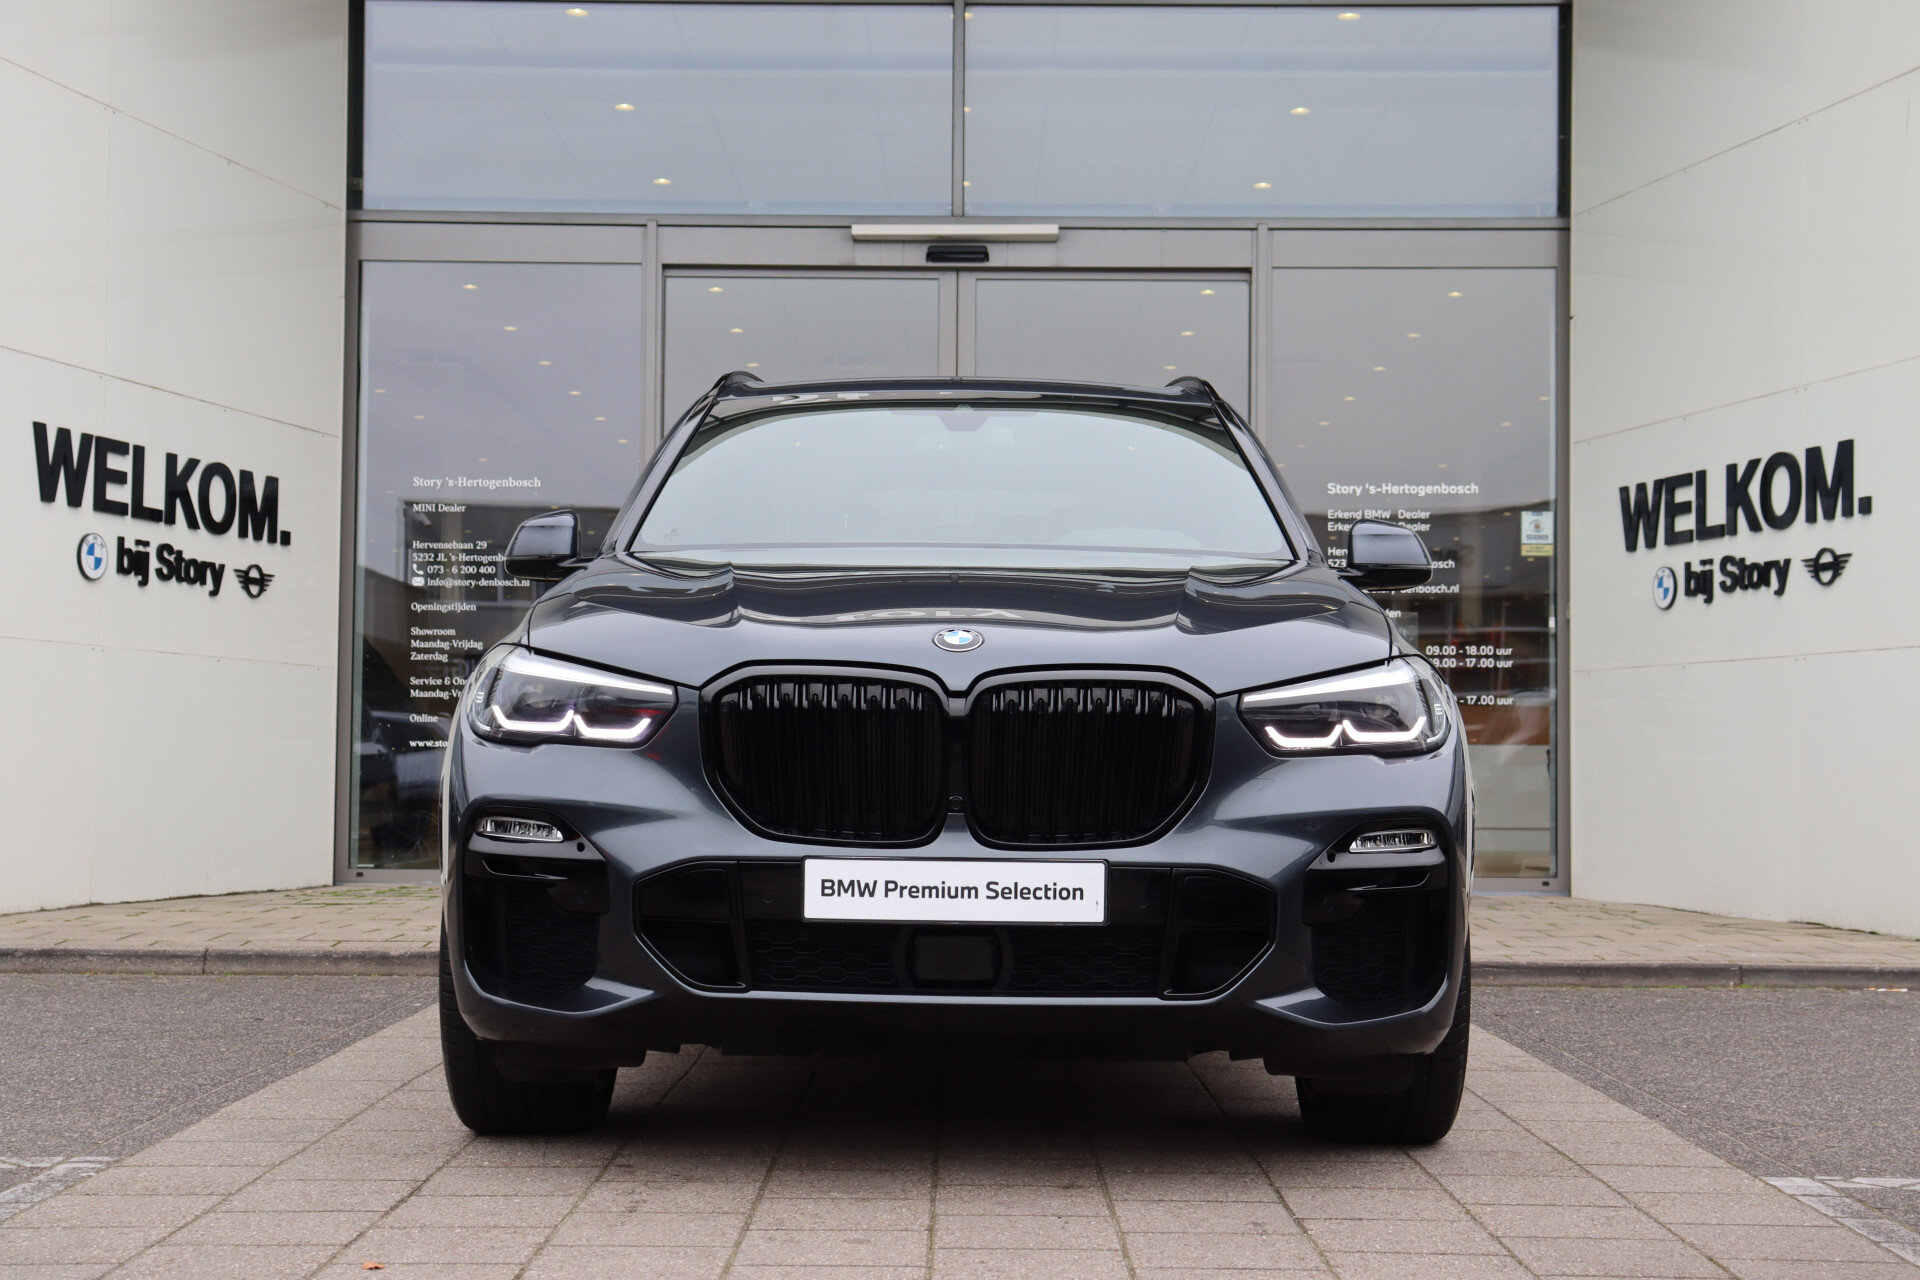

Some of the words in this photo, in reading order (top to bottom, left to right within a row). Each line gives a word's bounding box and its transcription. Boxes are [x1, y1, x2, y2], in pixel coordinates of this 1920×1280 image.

[32, 421, 291, 546] WELKOM.
[412, 476, 442, 489] Story
[1327, 483, 1362, 496] Story
[1619, 438, 1872, 552] WELKOM.
[412, 503, 436, 512] MINI
[437, 503, 466, 512] Dealer
[1327, 509, 1361, 519] Erkend
[1364, 510, 1391, 519] BMW
[1397, 509, 1431, 519] Dealer
[412, 540, 474, 549] Hervensebaan
[475, 540, 488, 549] 29
[412, 552, 434, 562] 5232
[436, 553, 448, 562] JL
[116, 536, 150, 587] bij
[155, 543, 225, 597] Story
[427, 565, 444, 574] 073
[451, 565, 458, 574] 6
[460, 565, 477, 574] 200
[478, 565, 496, 574] 400
[1684, 558, 1714, 605] bij
[1719, 555, 1791, 597] Story
[410, 602, 477, 613] Openingstijden
[410, 627, 456, 636] Showroom
[410, 639, 483, 650] Maandag-Vrijdag
[1425, 645, 1457, 655] 09.00
[1465, 645, 1494, 655] 18.00
[1495, 647, 1513, 655] uur
[410, 652, 449, 662] Zaterdag
[1495, 660, 1513, 668] uur
[409, 676, 442, 686] Service
[444, 677, 451, 686] &
[1496, 697, 1514, 705] uur
[409, 713, 438, 722] Online
[820, 878, 878, 898] BMW
[884, 879, 979, 900] Premium
[985, 880, 1084, 901] Selection
